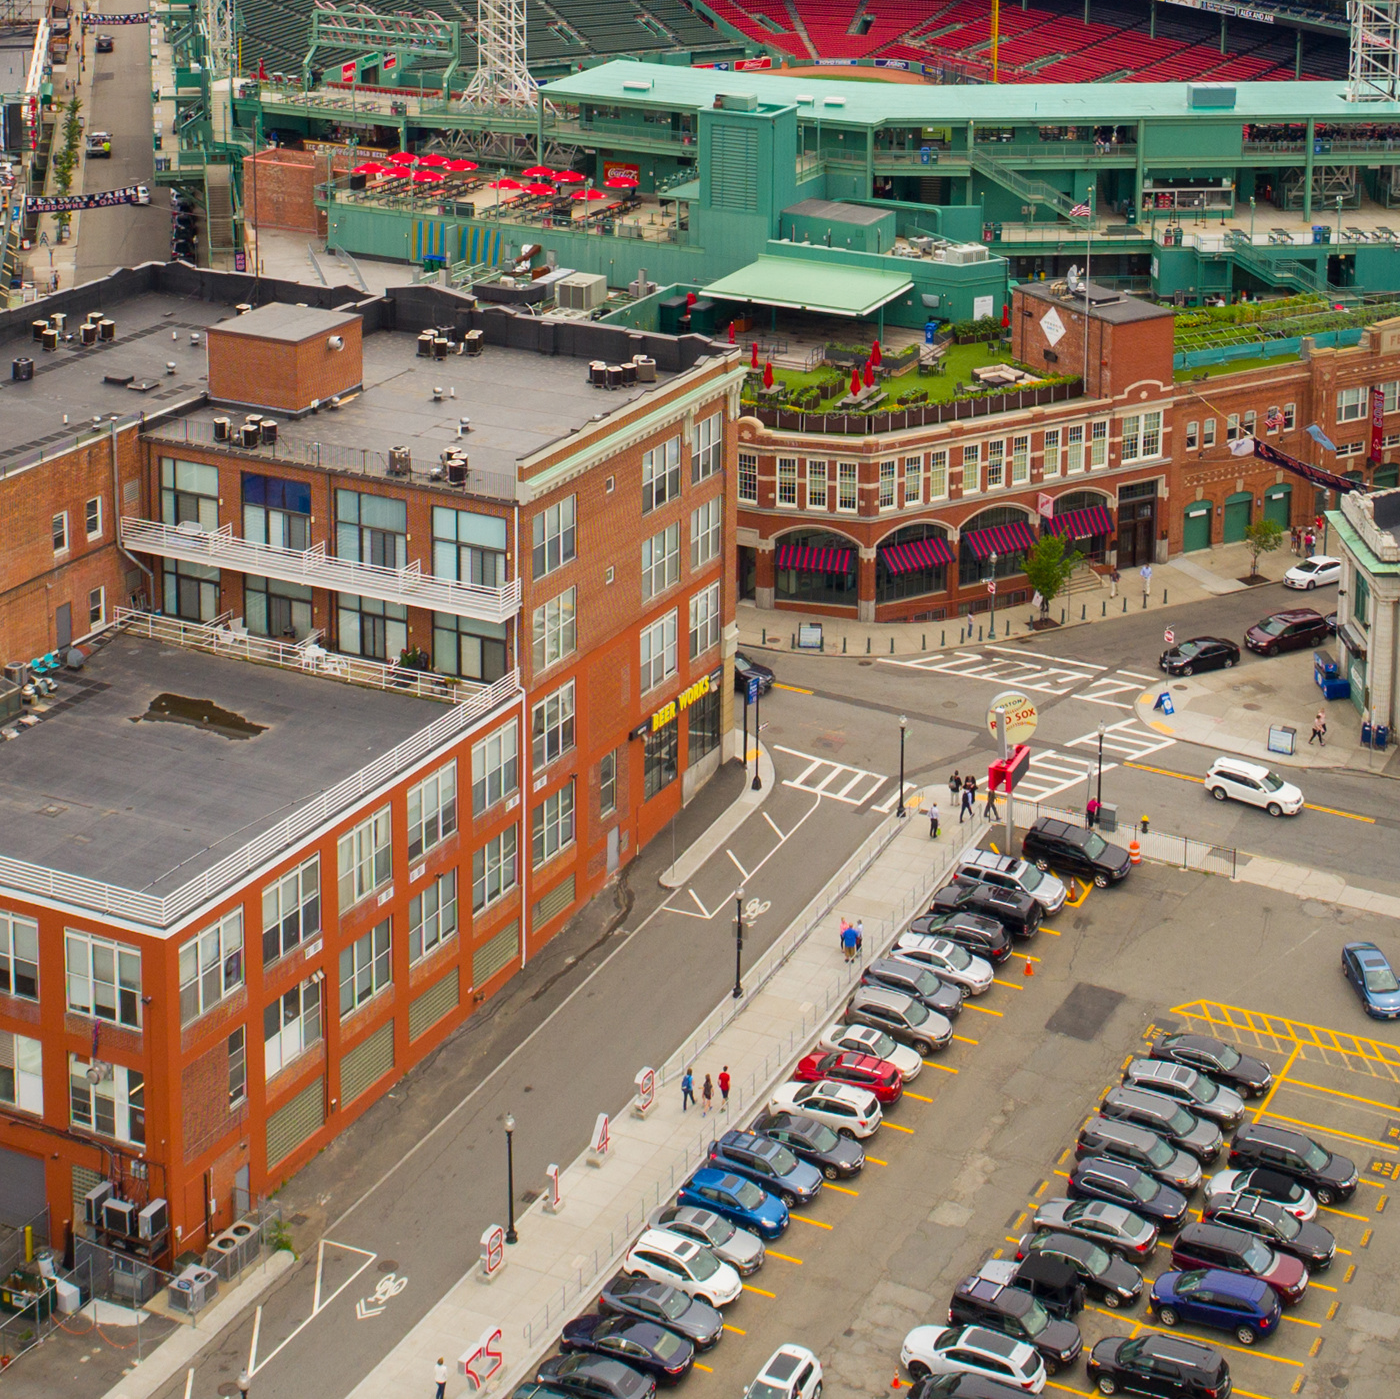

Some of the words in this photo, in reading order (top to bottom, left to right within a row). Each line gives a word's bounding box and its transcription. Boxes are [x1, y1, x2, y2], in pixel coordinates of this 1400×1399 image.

[27, 194, 88, 206] FENWAY
[94, 187, 138, 201] PARK
[27, 201, 86, 212] LANSDOWNE
[100, 197, 126, 206] GATE
[1373, 392, 1384, 428] 1903
[651, 700, 677, 732] BEER
[677, 674, 710, 711] WORKS
[989, 715, 1012, 730] RD
[1014, 707, 1036, 722] SOX
[638, 1068, 655, 1111] 9
[594, 1115, 611, 1154] 4
[484, 1226, 504, 1274] 8
